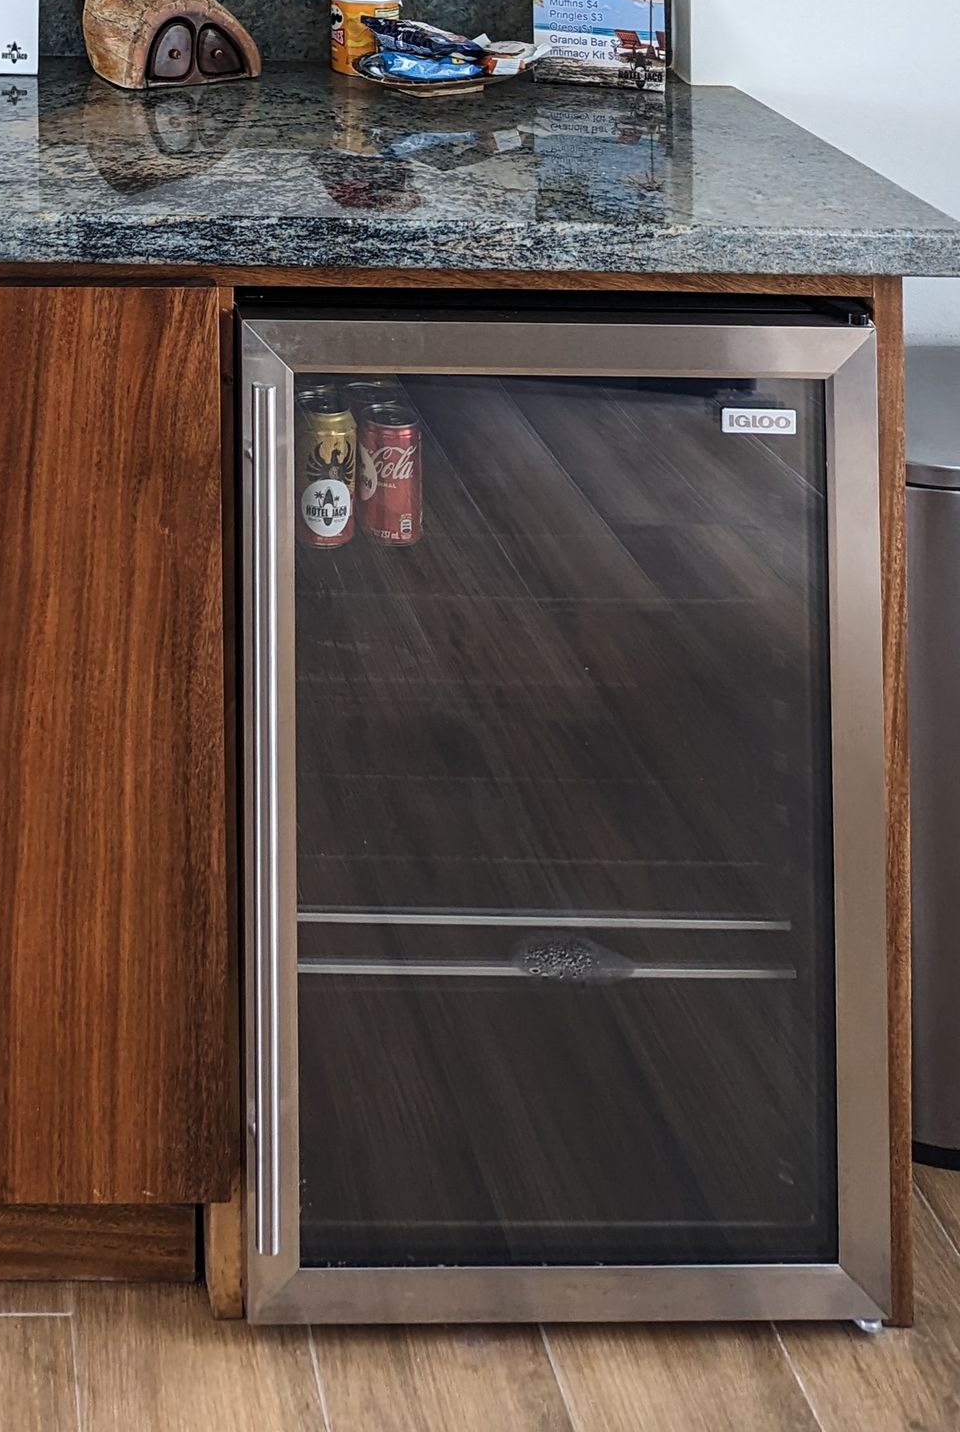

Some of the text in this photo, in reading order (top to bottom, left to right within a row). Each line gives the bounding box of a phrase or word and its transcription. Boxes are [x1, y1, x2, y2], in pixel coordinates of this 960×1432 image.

[586, 0, 598, 9] $4
[549, 10, 603, 22] Pringles $3
[550, 21, 578, 32] Oreos
[550, 34, 588, 45] Granola
[591, 37, 608, 47] Bar
[550, 48, 590, 59] Intimacy
[593, 50, 605, 60] Kit
[618, 68, 663, 82] HOTEL JACO
[728, 414, 791, 429] IGLOO
[306, 504, 328, 518] HOTEL
